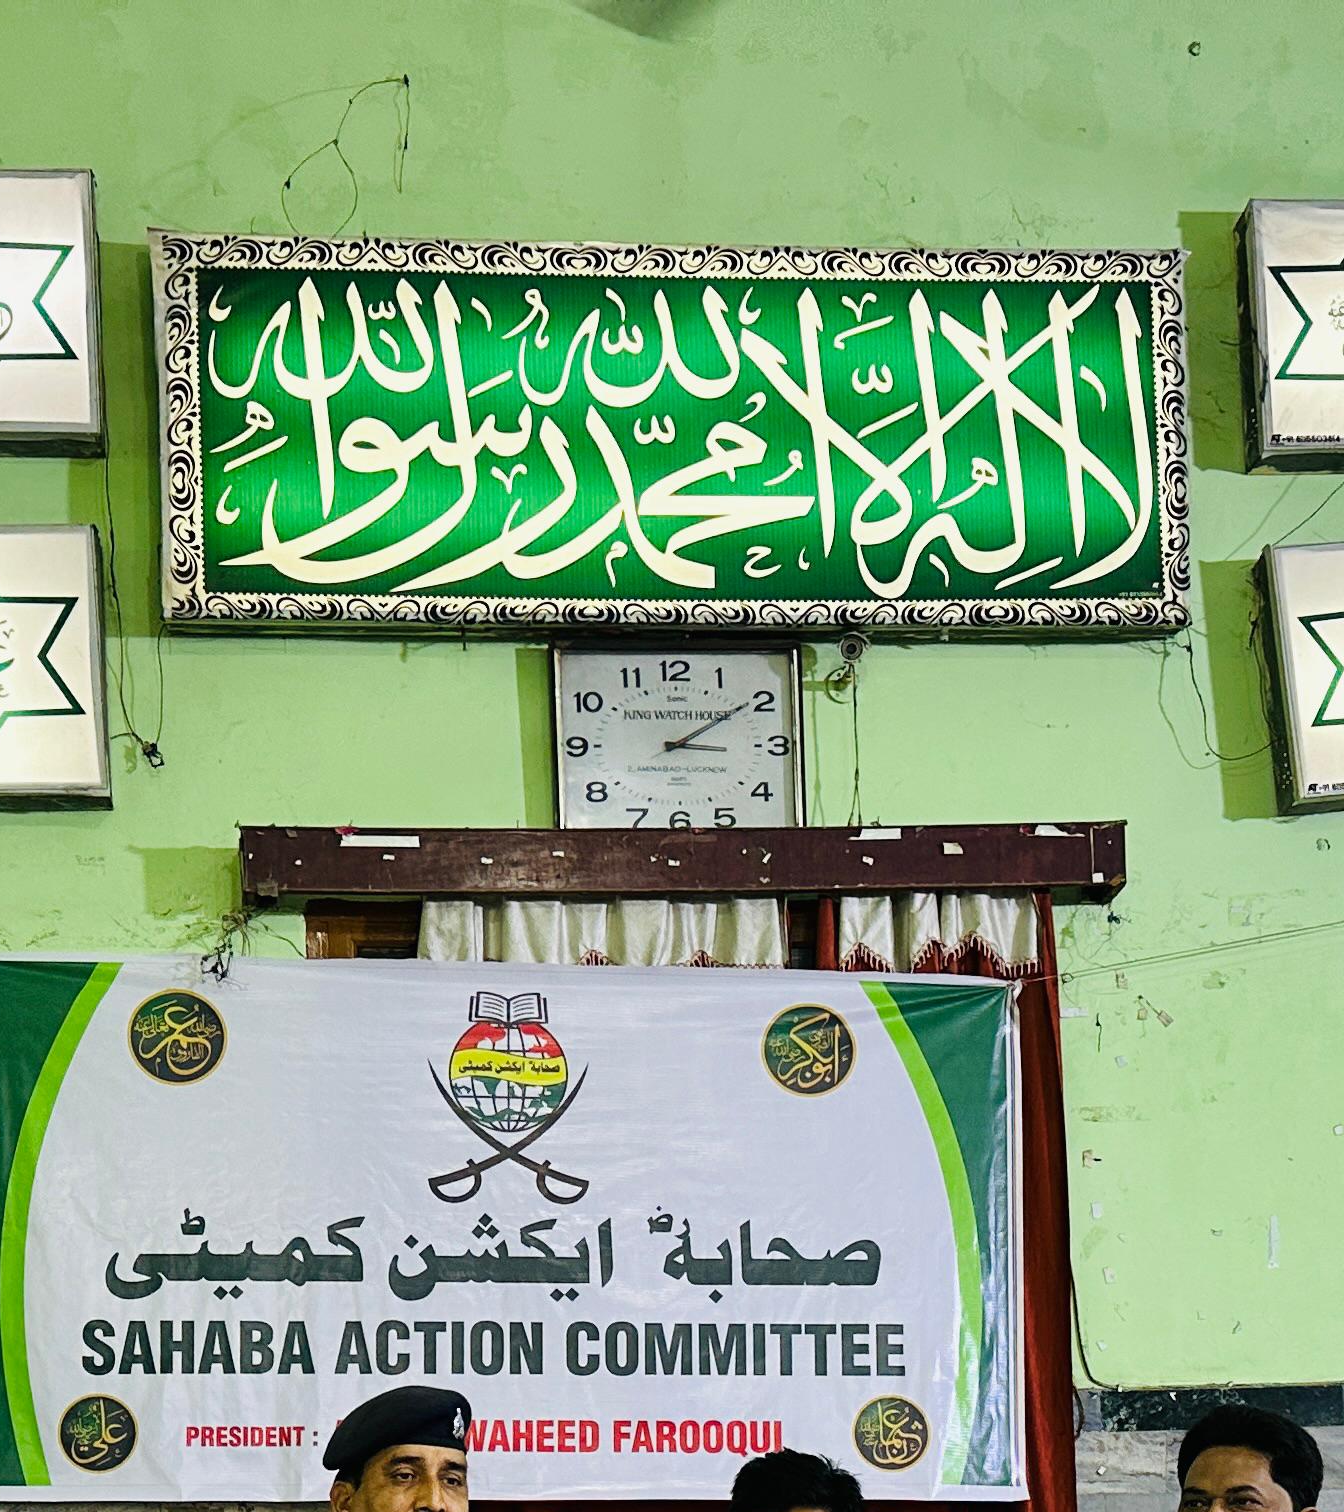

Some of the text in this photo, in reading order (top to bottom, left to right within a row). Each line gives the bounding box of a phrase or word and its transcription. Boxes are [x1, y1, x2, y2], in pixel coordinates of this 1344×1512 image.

[620, 667, 642, 688] 11
[659, 660, 691, 682] 12
[714, 667, 723, 689] 1
[573, 691, 603, 713] 10
[752, 691, 775, 713] 2
[624, 710, 732, 721] KING WATCH HOUSE
[565, 736, 589, 758] 9
[767, 735, 790, 757] 3
[585, 781, 609, 803] 8
[751, 781, 774, 802] 4
[625, 808, 649, 828] 7
[669, 811, 691, 828] 6
[714, 807, 737, 828] 5
[81, 1319, 906, 1377] SAHABA ACTION COMMITTEE
[185, 1426, 305, 1447] PRESIDENT
[464, 1420, 600, 1453] WAHEED
[613, 1420, 782, 1457] FAROOQUI
